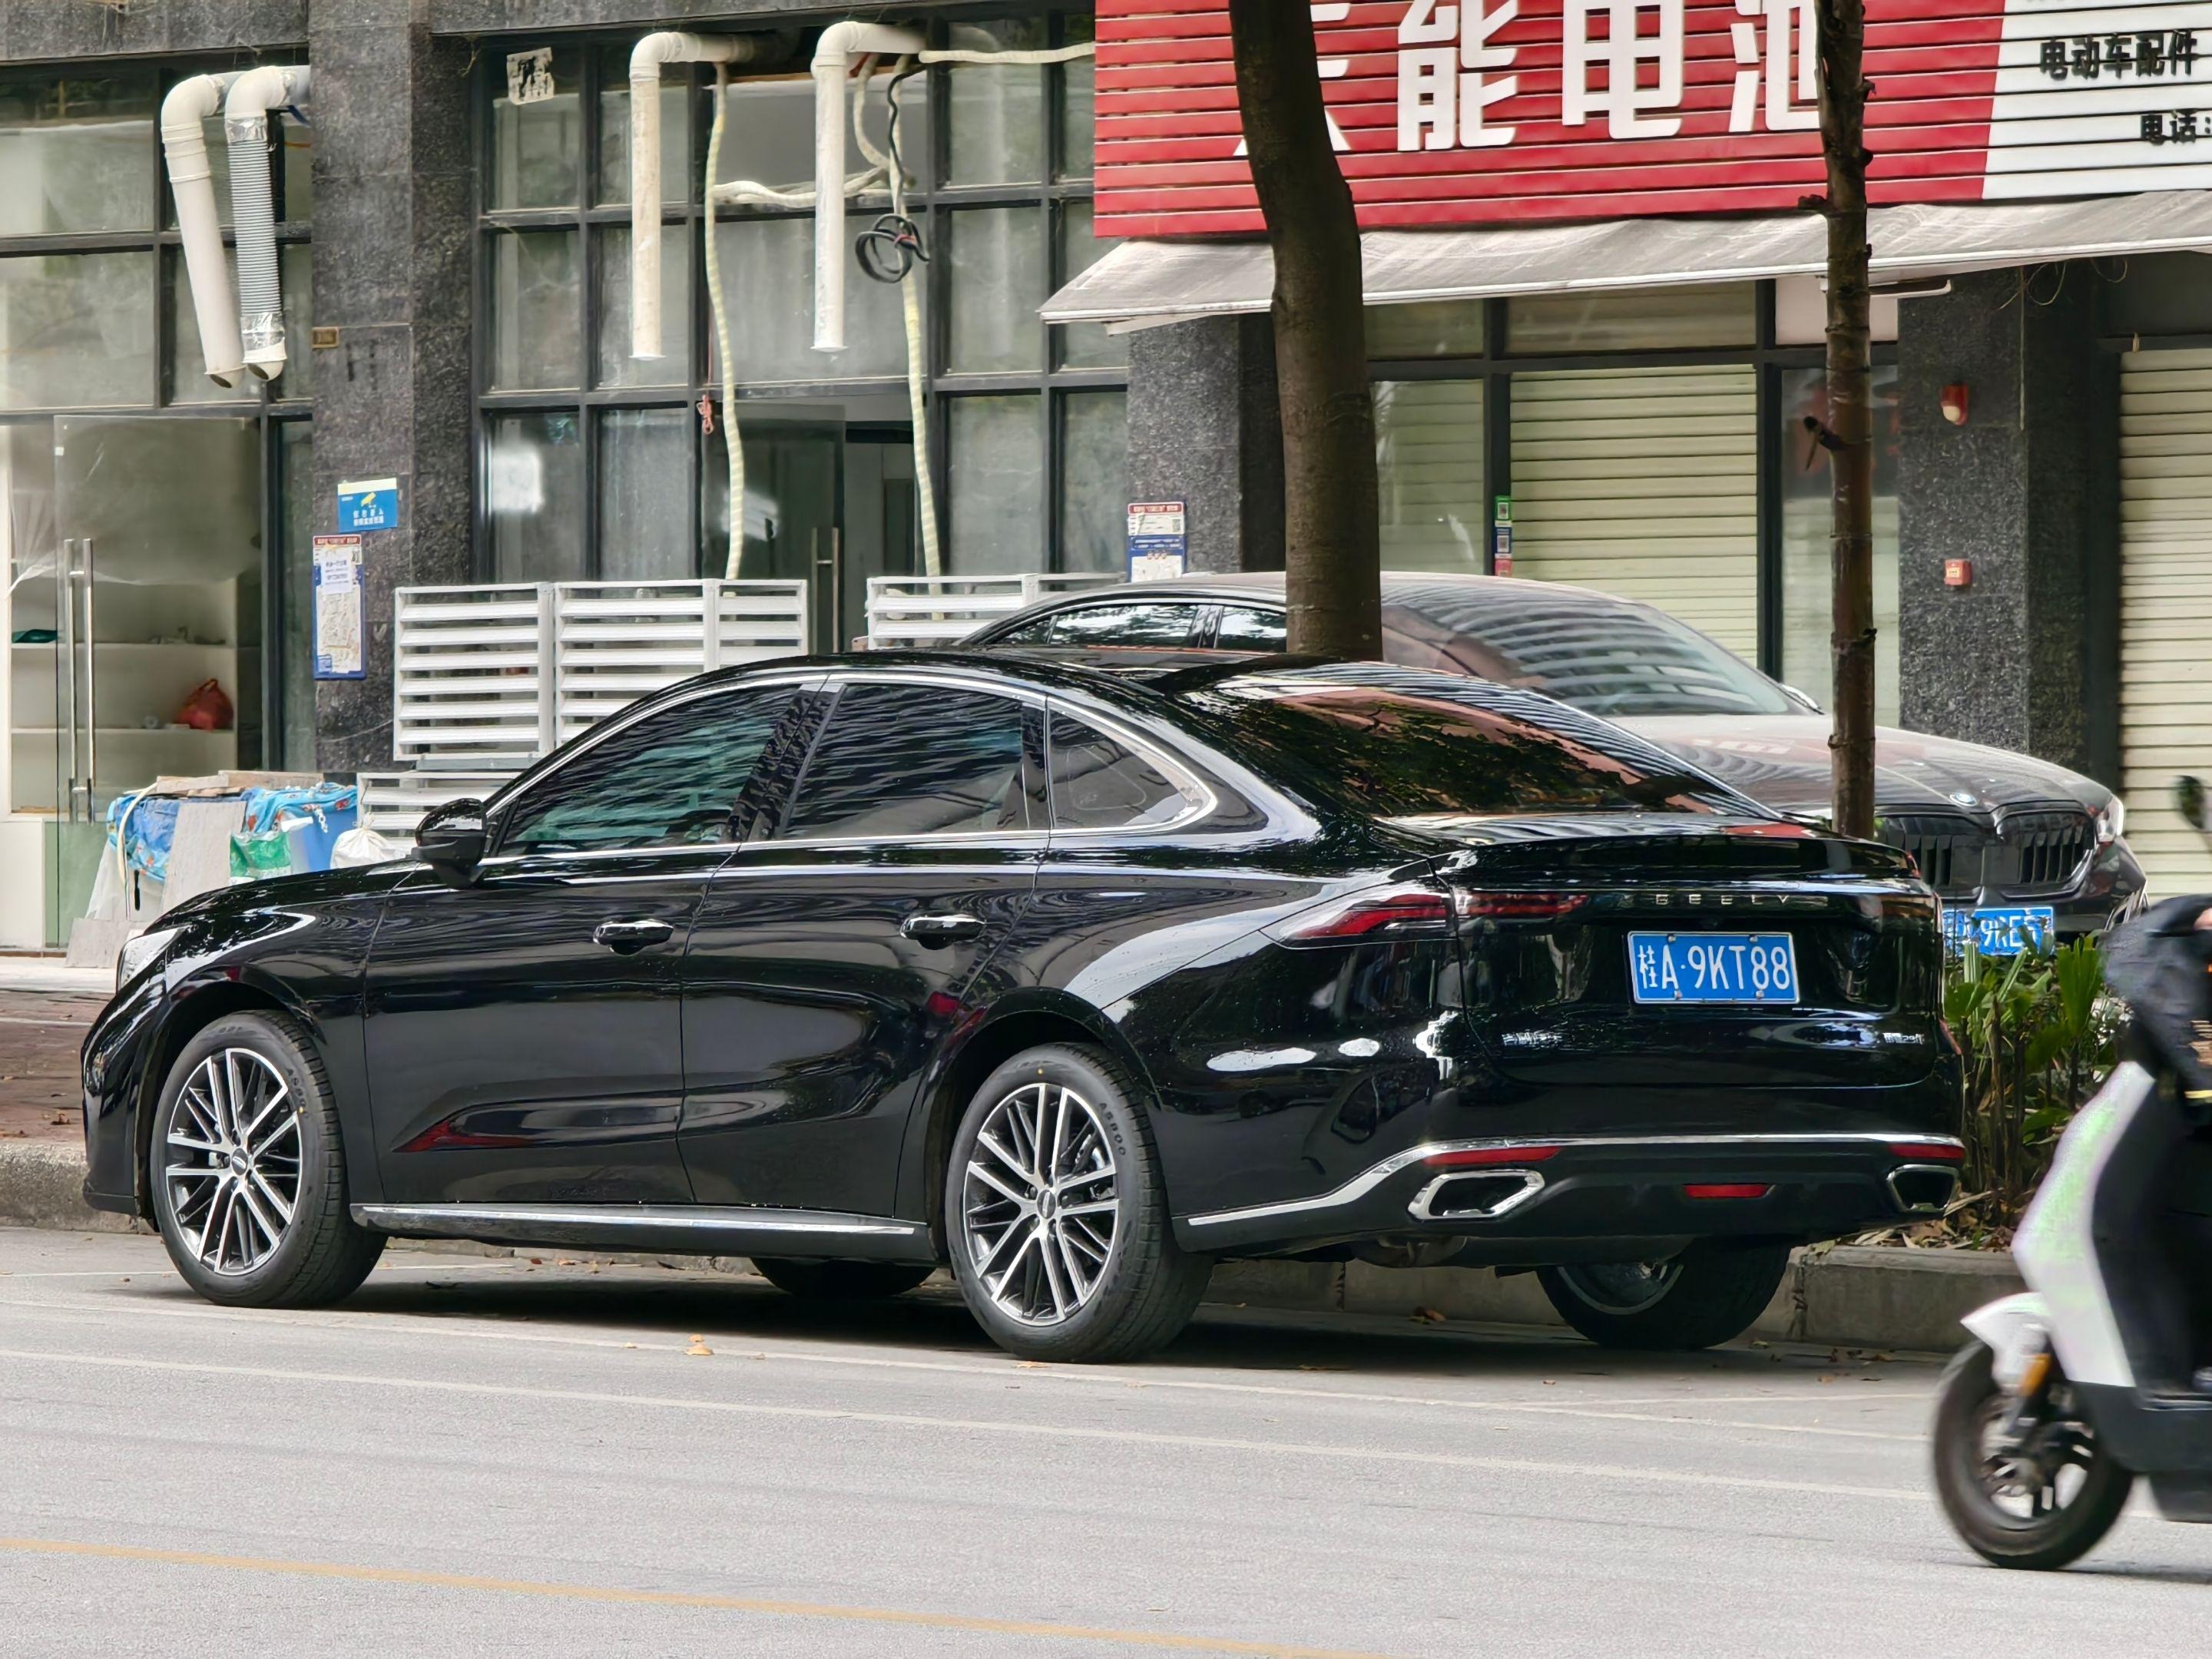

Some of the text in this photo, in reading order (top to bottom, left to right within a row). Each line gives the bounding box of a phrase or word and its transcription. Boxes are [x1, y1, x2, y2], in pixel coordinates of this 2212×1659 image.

[1233, 0, 1820, 151] 能电池
[2040, 29, 2197, 80] 电动车配件
[1637, 945, 1790, 990] 桂A·9KT88
